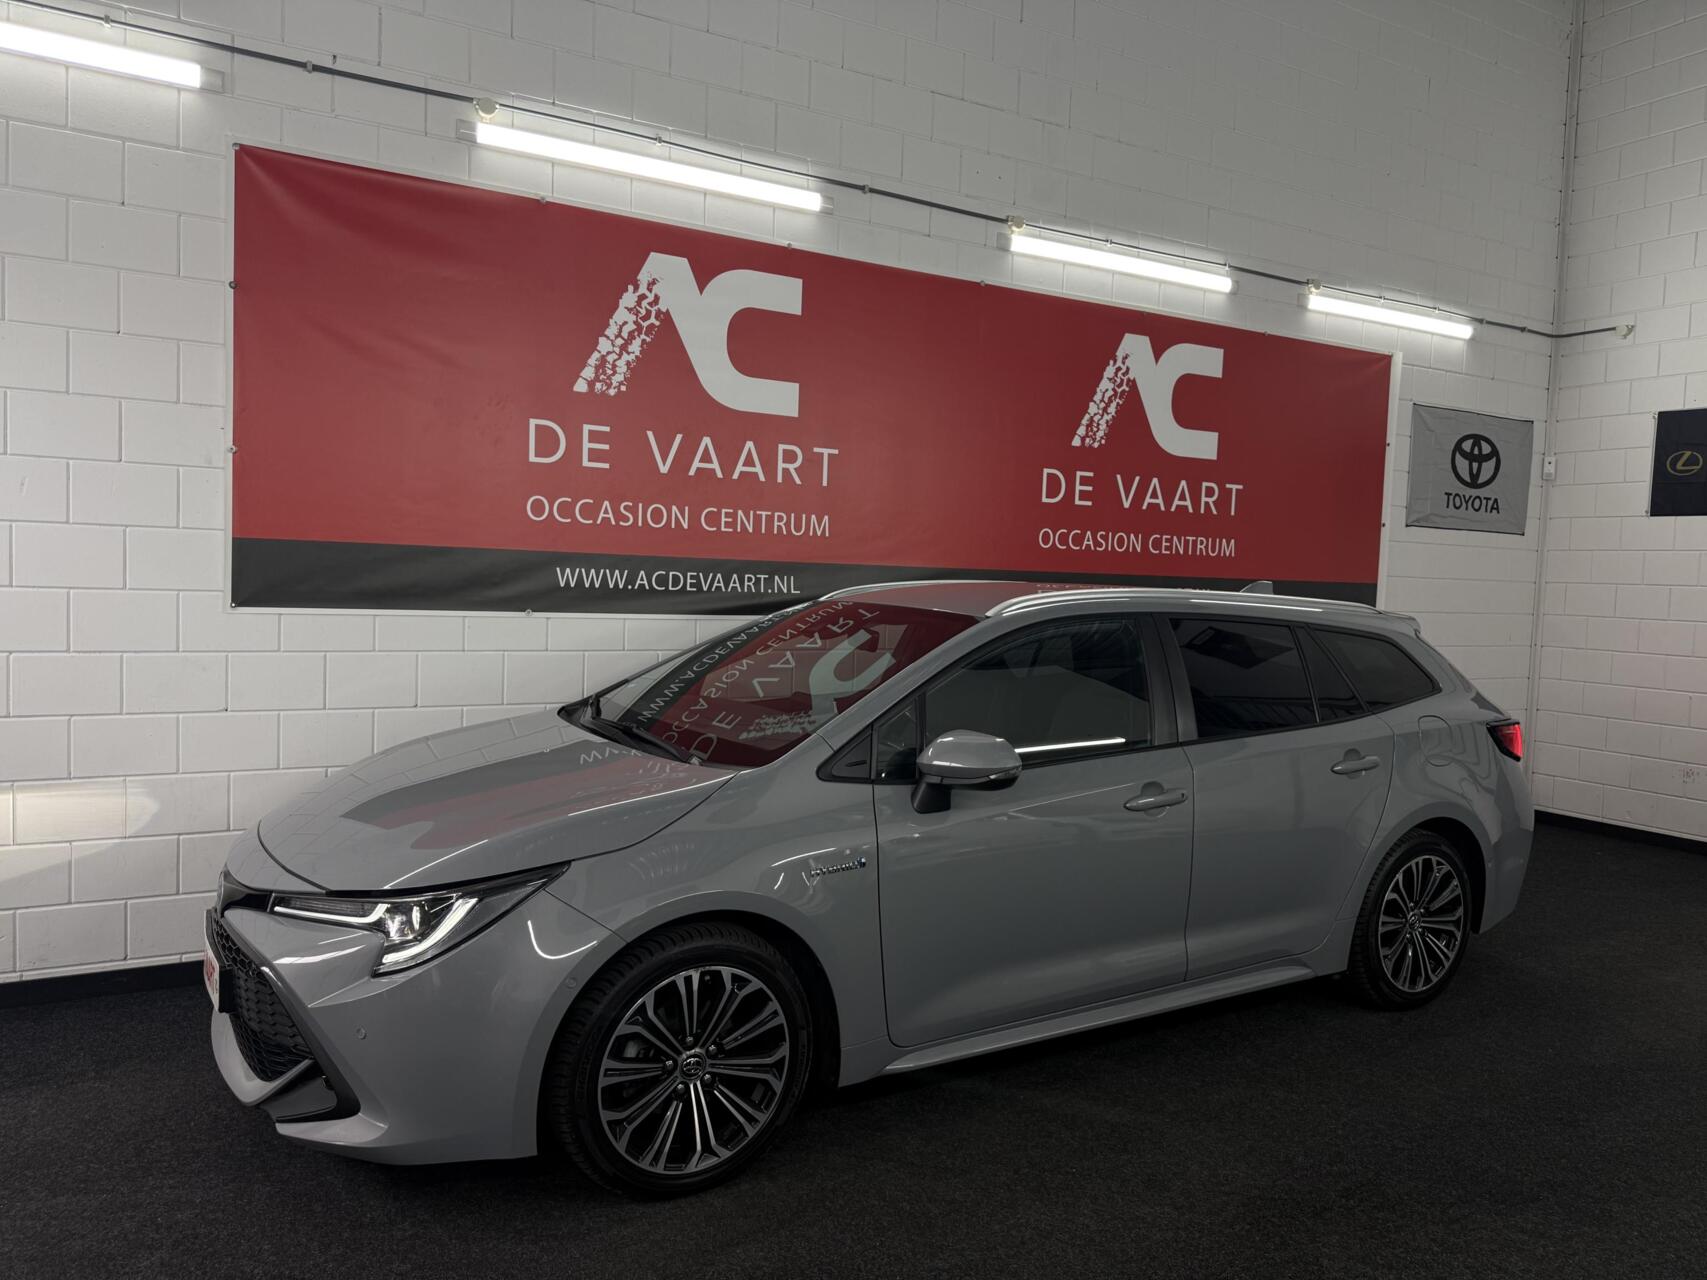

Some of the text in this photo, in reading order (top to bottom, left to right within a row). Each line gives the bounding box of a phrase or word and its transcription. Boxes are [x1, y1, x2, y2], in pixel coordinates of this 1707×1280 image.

[573, 251, 803, 418] AC
[1071, 332, 1225, 461] AC
[528, 417, 839, 487] DE VAART
[1041, 467, 1244, 516] DE VAART
[1444, 491, 1500, 514] TOYOTA
[526, 495, 830, 537] OCCASION CENTRUM
[1038, 527, 1236, 558] OCCASION CENTRUM
[556, 566, 801, 595] WWW.ACDEVAART.NL
